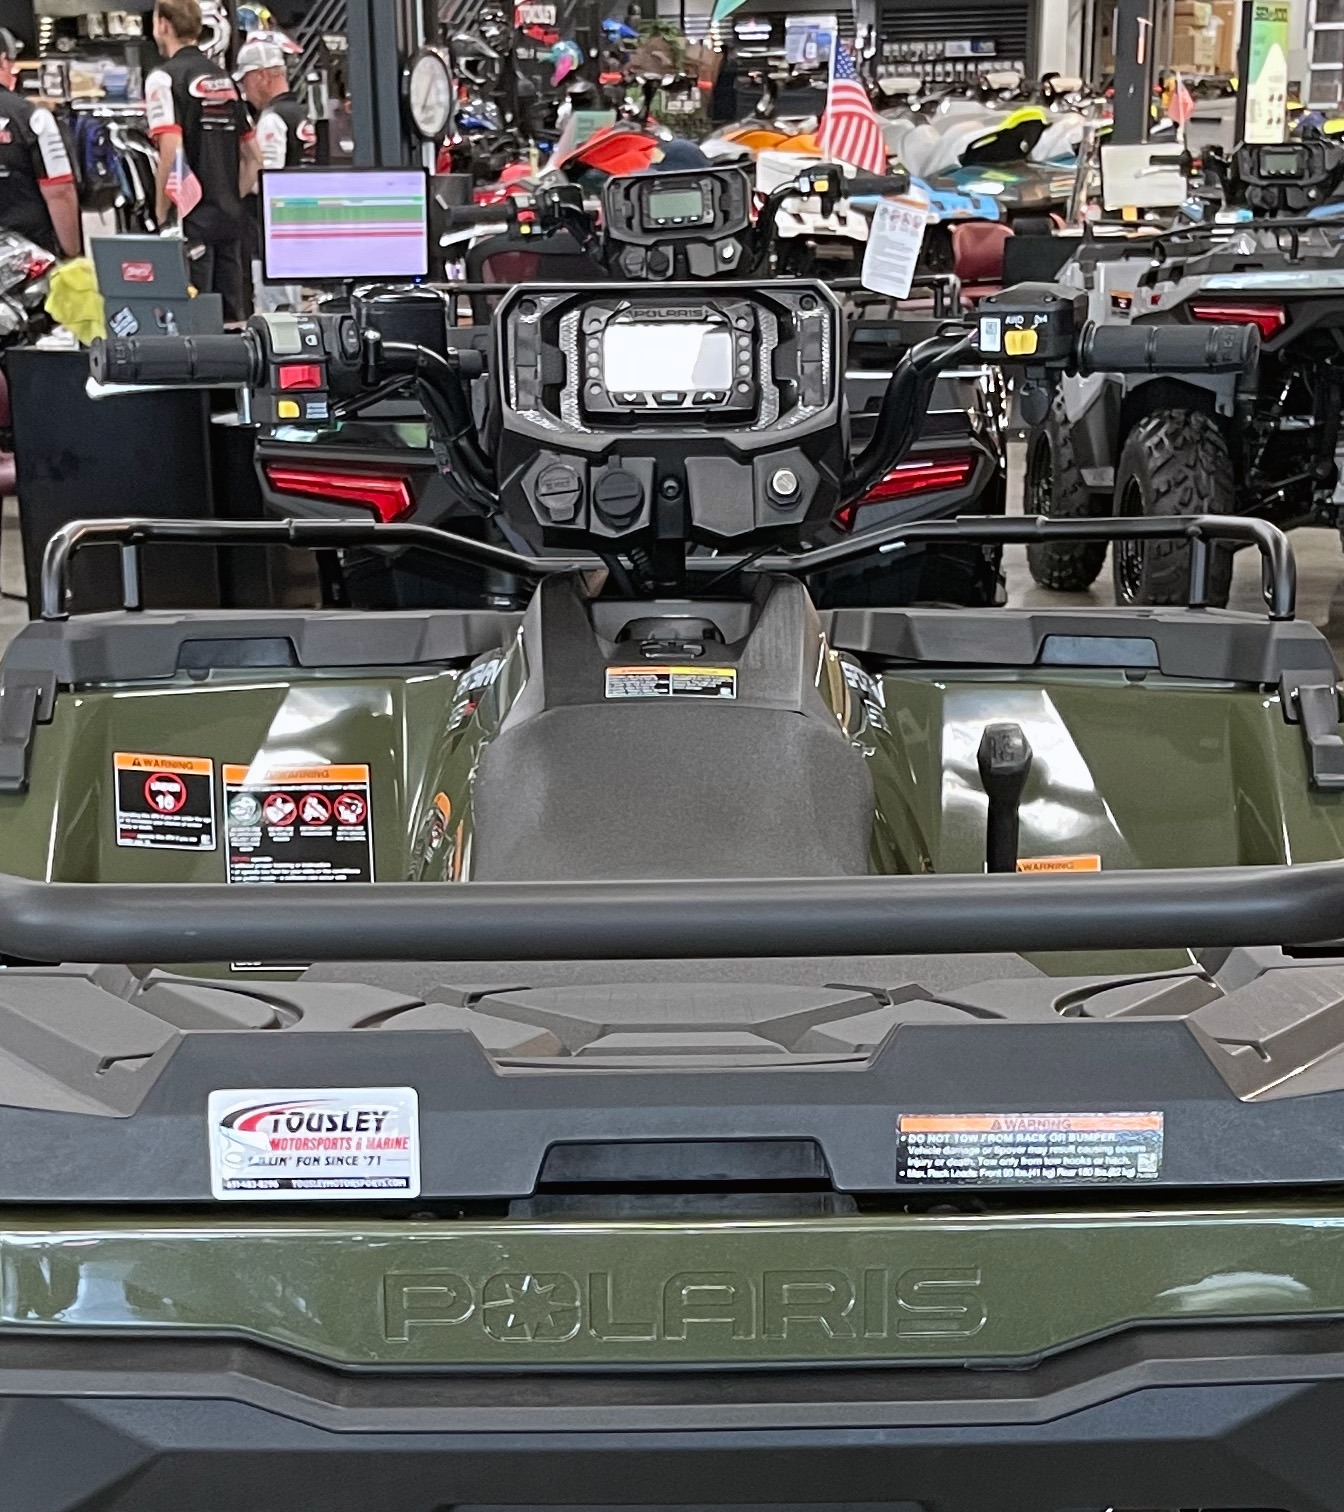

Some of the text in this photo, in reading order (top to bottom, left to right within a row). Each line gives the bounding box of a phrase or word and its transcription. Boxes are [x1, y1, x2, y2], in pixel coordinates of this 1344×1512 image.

[634, 309, 703, 319] POLARIS
[144, 758, 194, 770] WARNING
[1022, 862, 1074, 872] WARNING
[268, 1110, 389, 1133] TOUSLEY
[1004, 1119, 1072, 1131] WARNING
[269, 1137, 352, 1151] MOTORSPORTS
[365, 1136, 410, 1151] MARINE
[908, 1133, 926, 1144] DO
[926, 1133, 952, 1144] NOT
[954, 1133, 978, 1143] TOW
[981, 1133, 1014, 1143] FROM
[1016, 1133, 1047, 1143] RACK
[1049, 1133, 1066, 1143] OR
[942, 1146, 981, 1156] damage
[296, 1155, 322, 1167] FUN
[324, 1155, 358, 1167] SINCE
[382, 1270, 988, 1342] POLARIS
